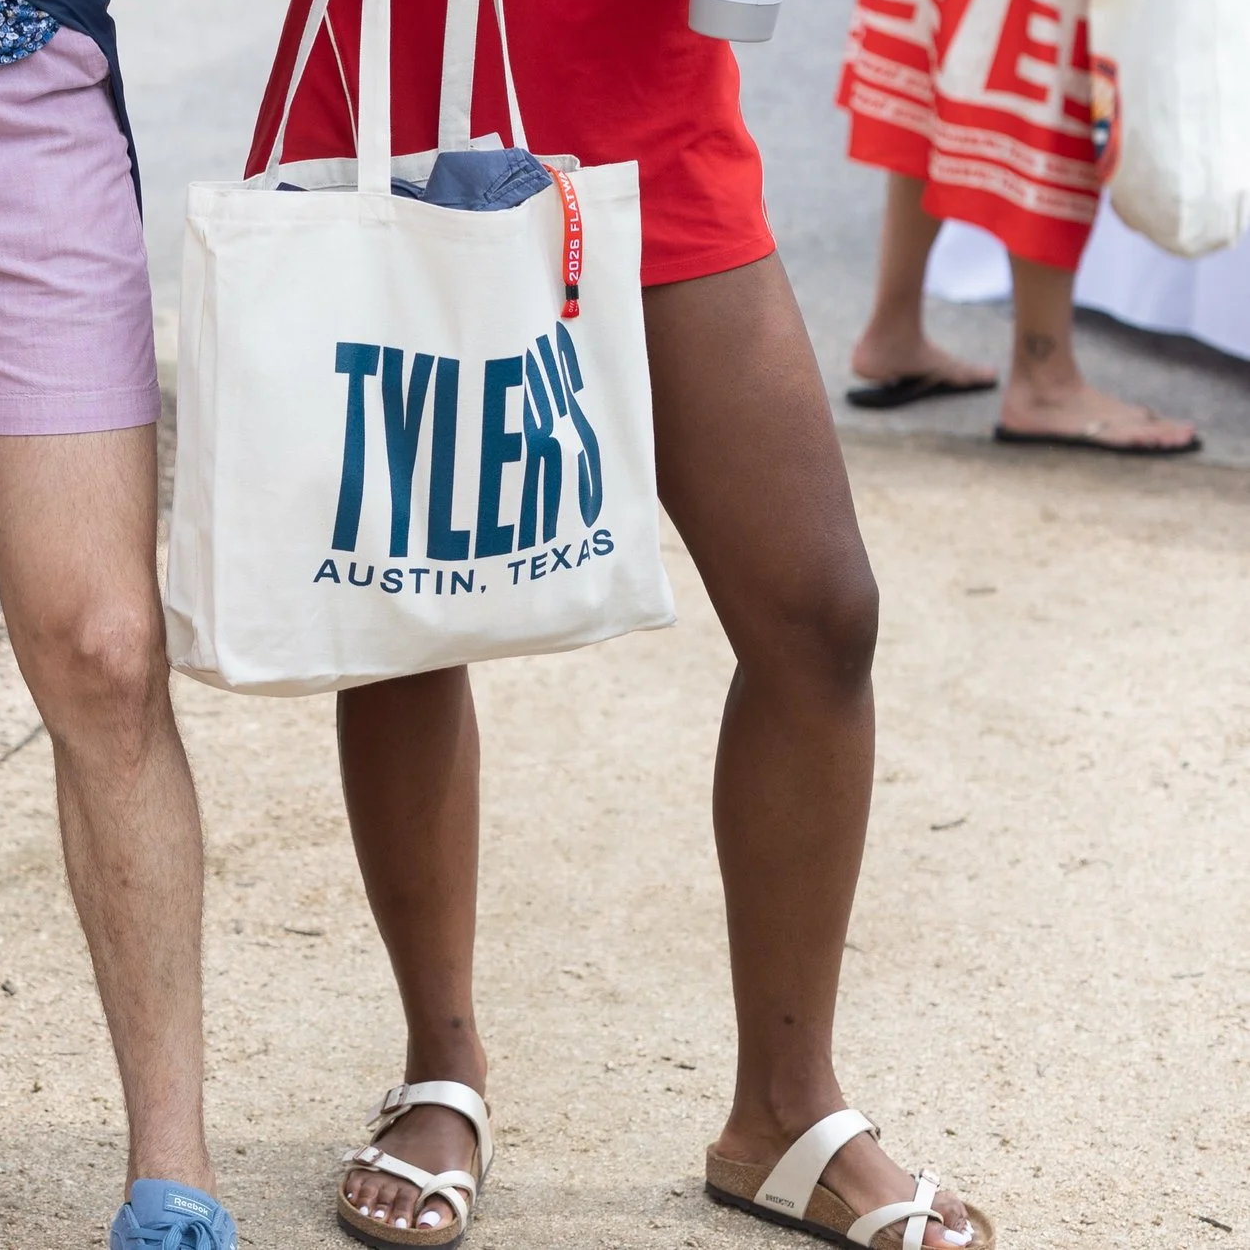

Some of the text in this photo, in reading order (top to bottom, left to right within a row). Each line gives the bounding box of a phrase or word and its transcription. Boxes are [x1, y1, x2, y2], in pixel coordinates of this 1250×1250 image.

[568, 238, 581, 282] 2026
[331, 320, 603, 561] TYLER'S
[312, 529, 615, 595] AUSTIN, TEXAS
[173, 1197, 209, 1216] Reebok
